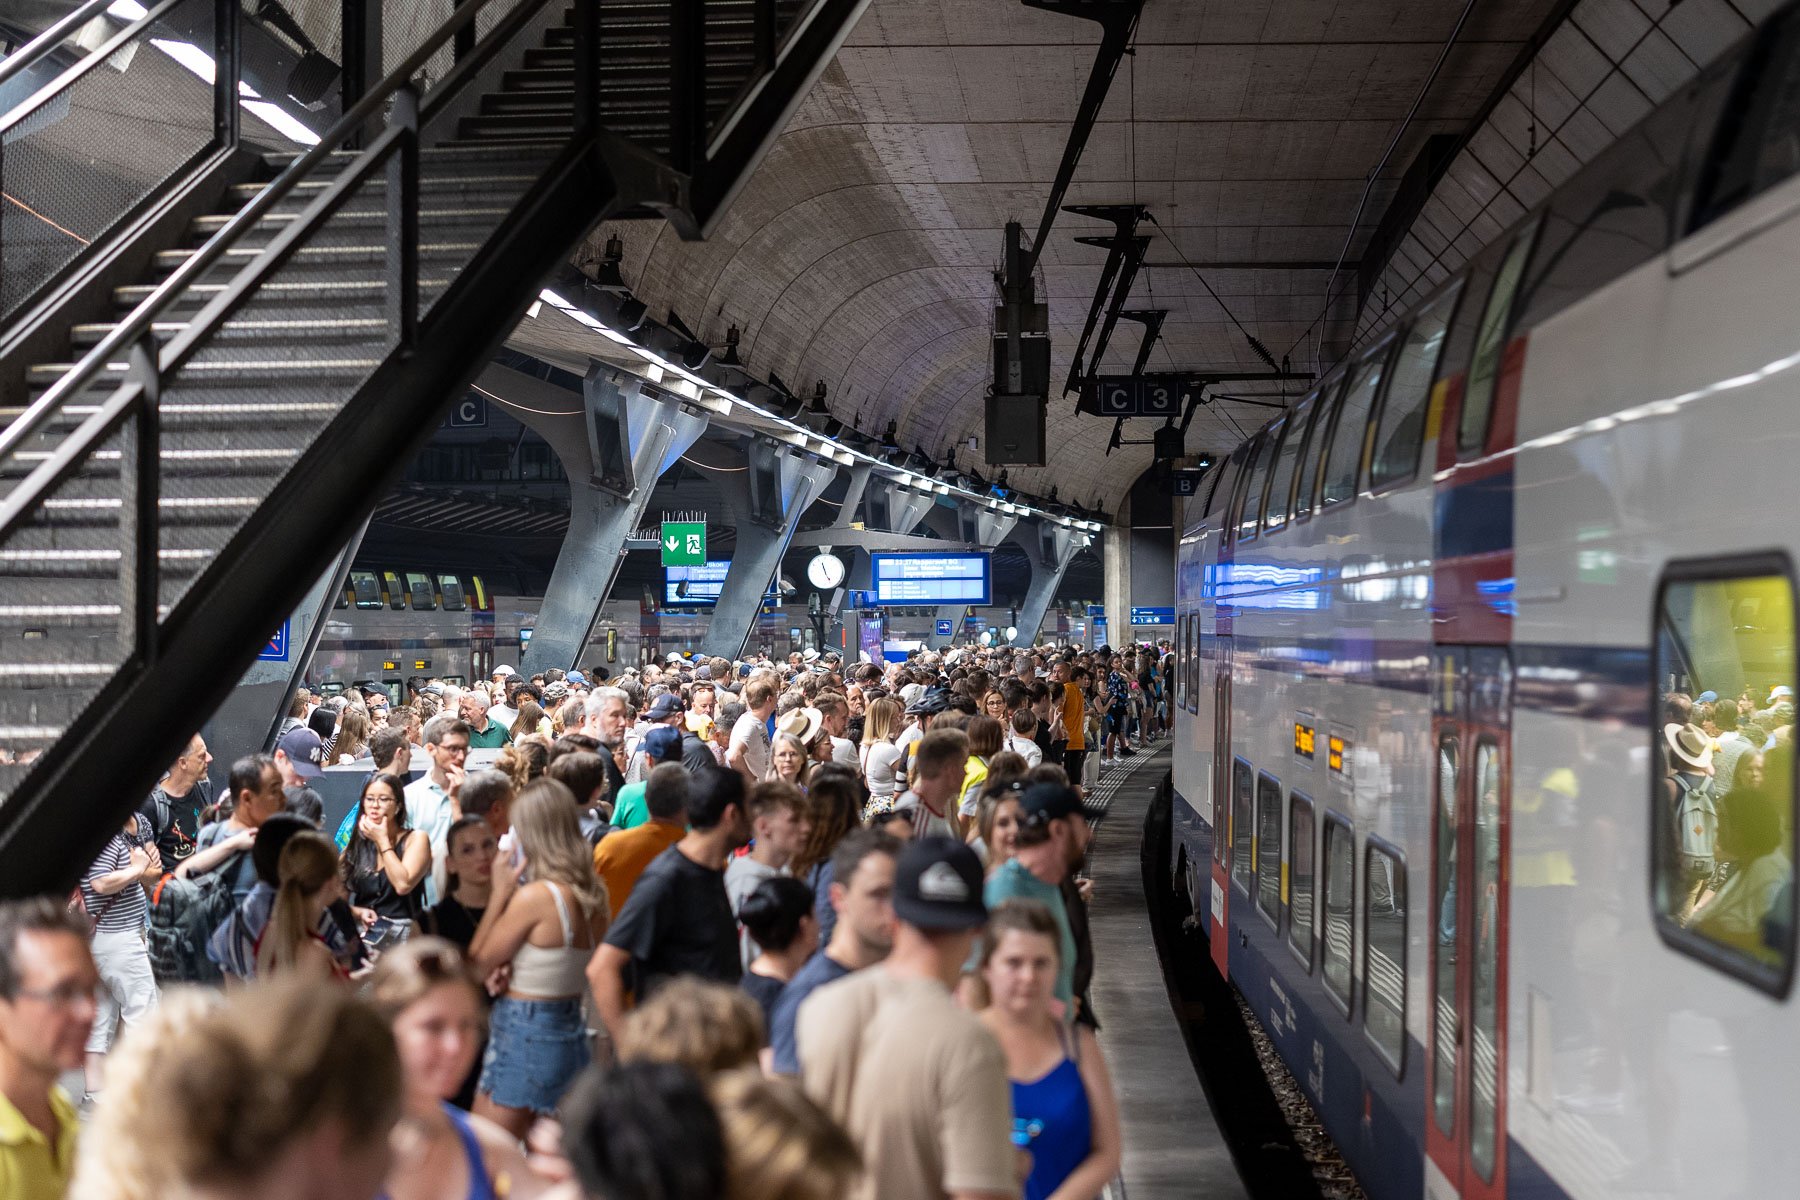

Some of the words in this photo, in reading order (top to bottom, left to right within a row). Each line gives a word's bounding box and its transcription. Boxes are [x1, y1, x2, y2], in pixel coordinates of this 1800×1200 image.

[1111, 389, 1128, 409] C
[1152, 388, 1168, 409] 3
[459, 402, 476, 422] C
[1180, 479, 1191, 492] B
